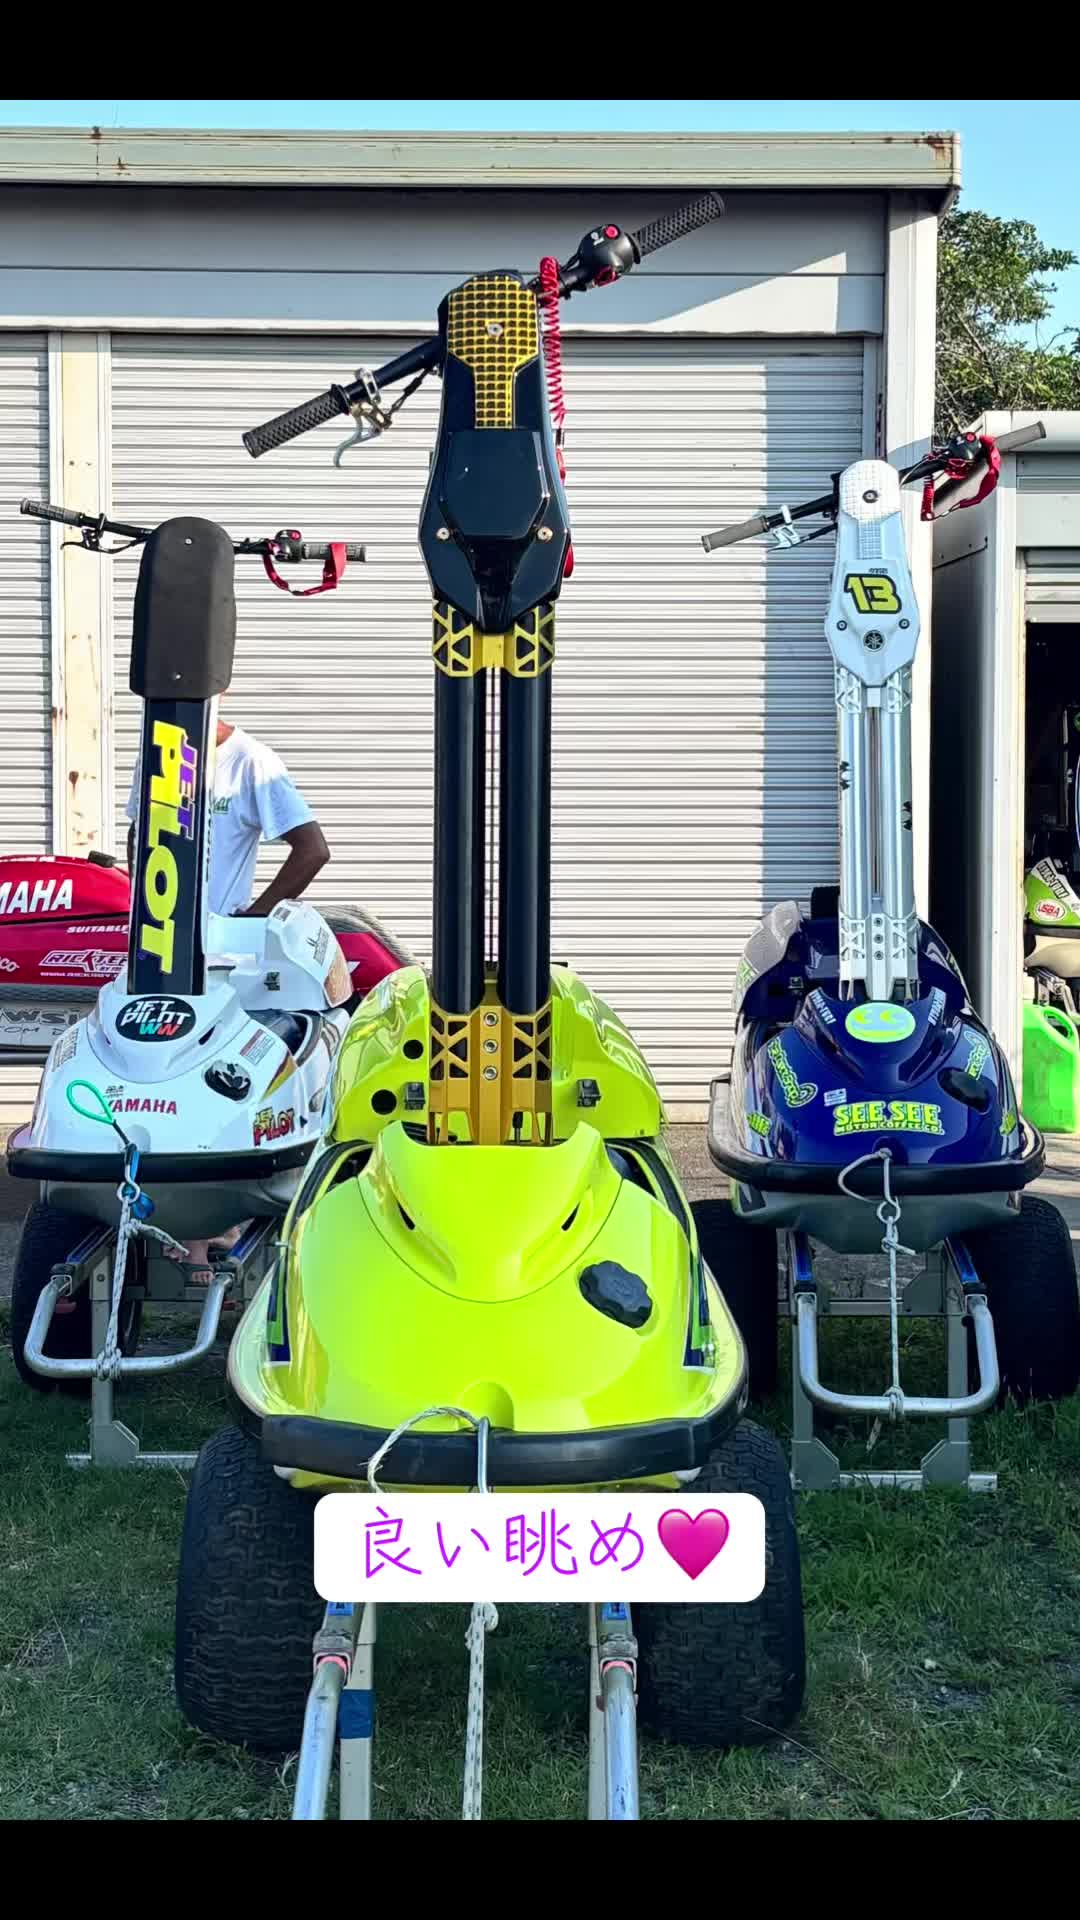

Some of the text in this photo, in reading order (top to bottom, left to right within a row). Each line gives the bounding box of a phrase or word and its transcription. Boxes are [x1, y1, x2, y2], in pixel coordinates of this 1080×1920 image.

[844, 573, 902, 614] 13
[177, 742, 198, 841] JET
[141, 720, 187, 975] PILOT
[121, 1011, 191, 1026] PILOT
[125, 1000, 175, 1014] JET
[139, 1022, 179, 1035] WW
[253, 1108, 296, 1146] PILOT
[835, 1102, 939, 1125] SEE SEE
